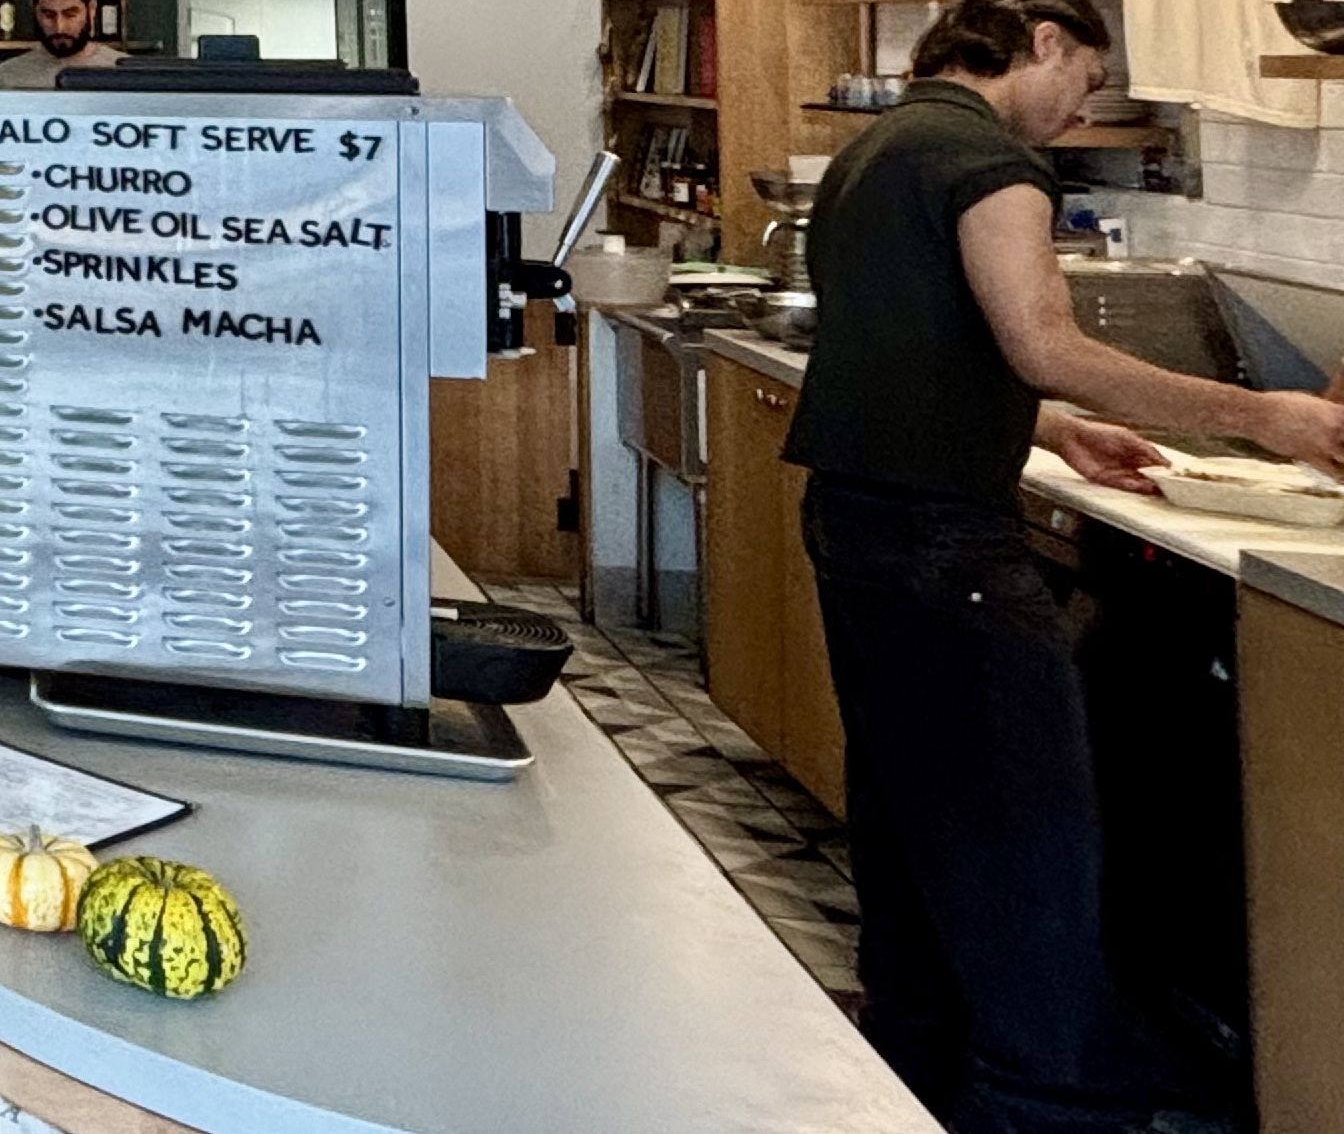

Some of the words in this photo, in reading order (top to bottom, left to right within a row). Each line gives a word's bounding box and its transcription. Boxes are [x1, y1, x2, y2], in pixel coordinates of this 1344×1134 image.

[92, 121, 186, 150] SOFT
[201, 126, 315, 154] SERVE
[338, 130, 383, 162] $7
[43, 164, 192, 197] CHURRO
[41, 203, 141, 235] OLIVE
[150, 210, 211, 240] OIL
[222, 216, 290, 245] SEA
[299, 217, 393, 251] SALT
[42, 248, 239, 291] SPRINKLES
[42, 304, 162, 338] SALSA
[181, 308, 322, 346] MACHA
